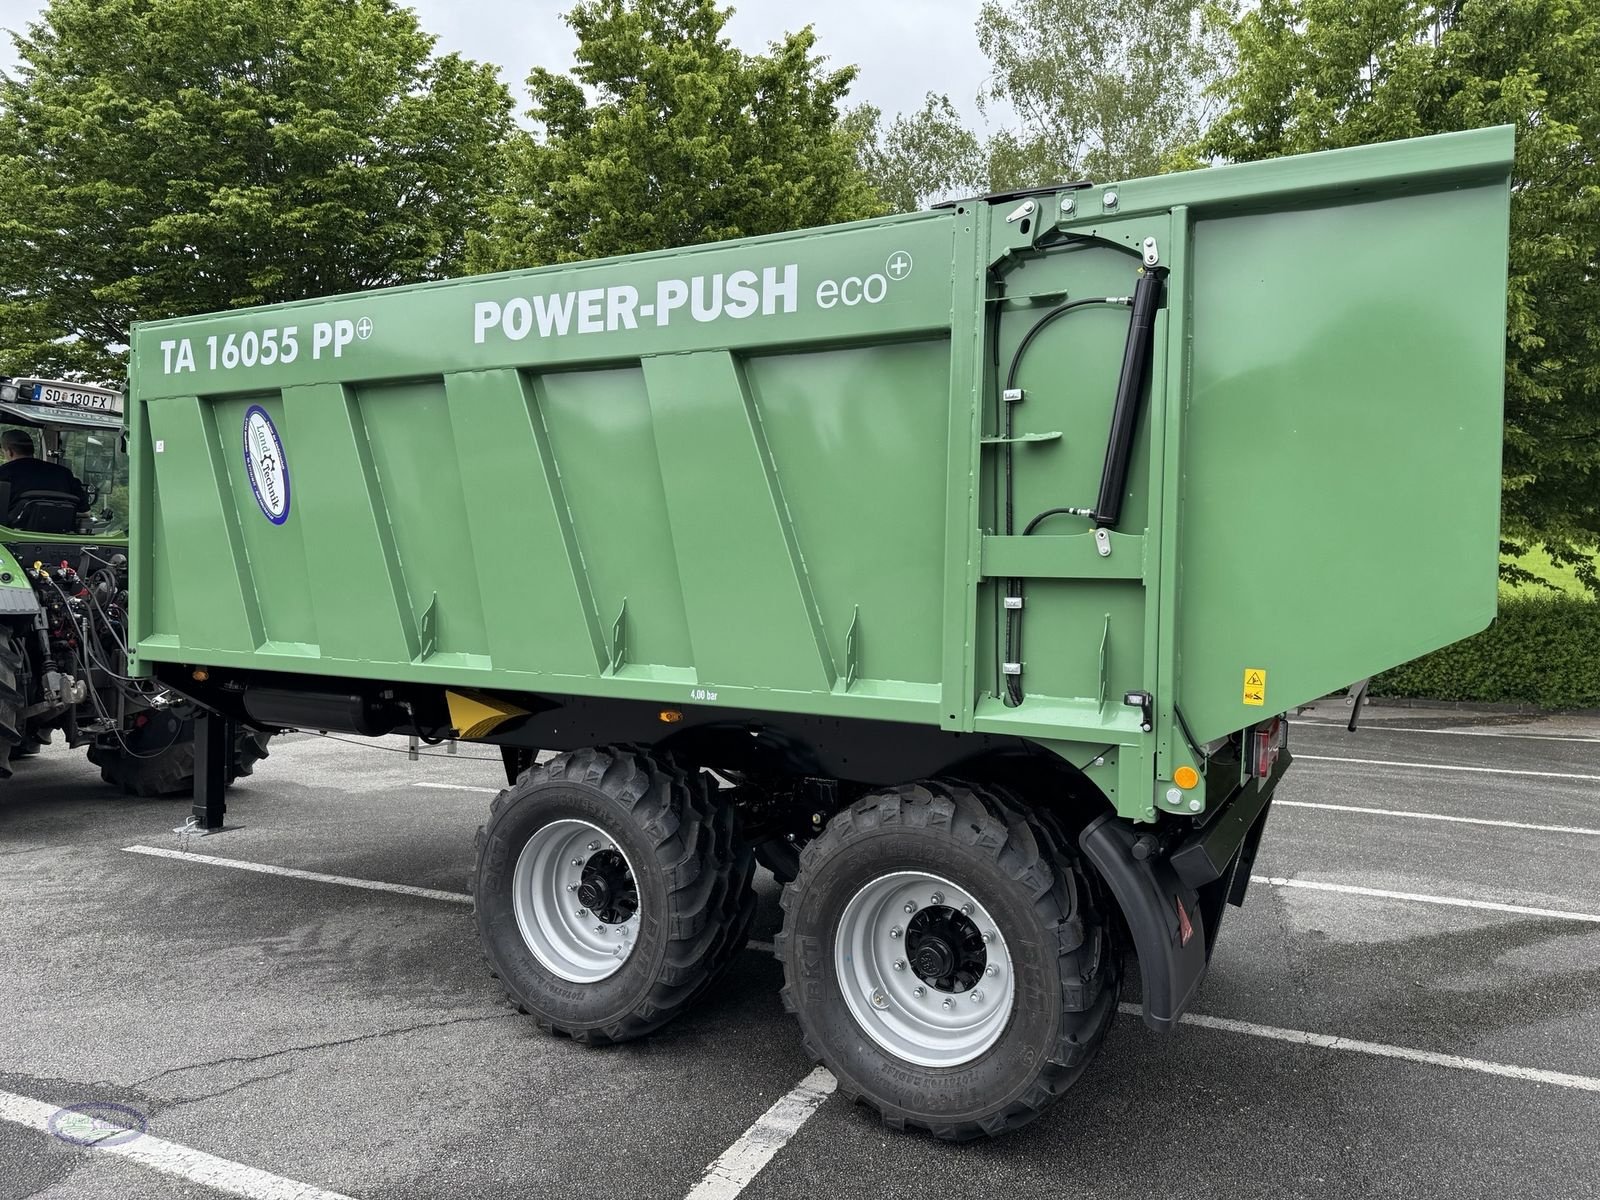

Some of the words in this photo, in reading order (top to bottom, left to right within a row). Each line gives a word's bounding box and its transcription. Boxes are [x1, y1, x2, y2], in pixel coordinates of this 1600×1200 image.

[474, 264, 798, 344] POWER-PUSH
[160, 339, 196, 374] TA
[206, 326, 299, 370] 16055
[45, 389, 61, 402] SD
[70, 392, 90, 407] 130
[91, 396, 107, 408] FX
[256, 424, 271, 453] Land
[262, 462, 279, 510] Technik
[690, 689, 705, 701] 4,00
[706, 690, 718, 701] bar
